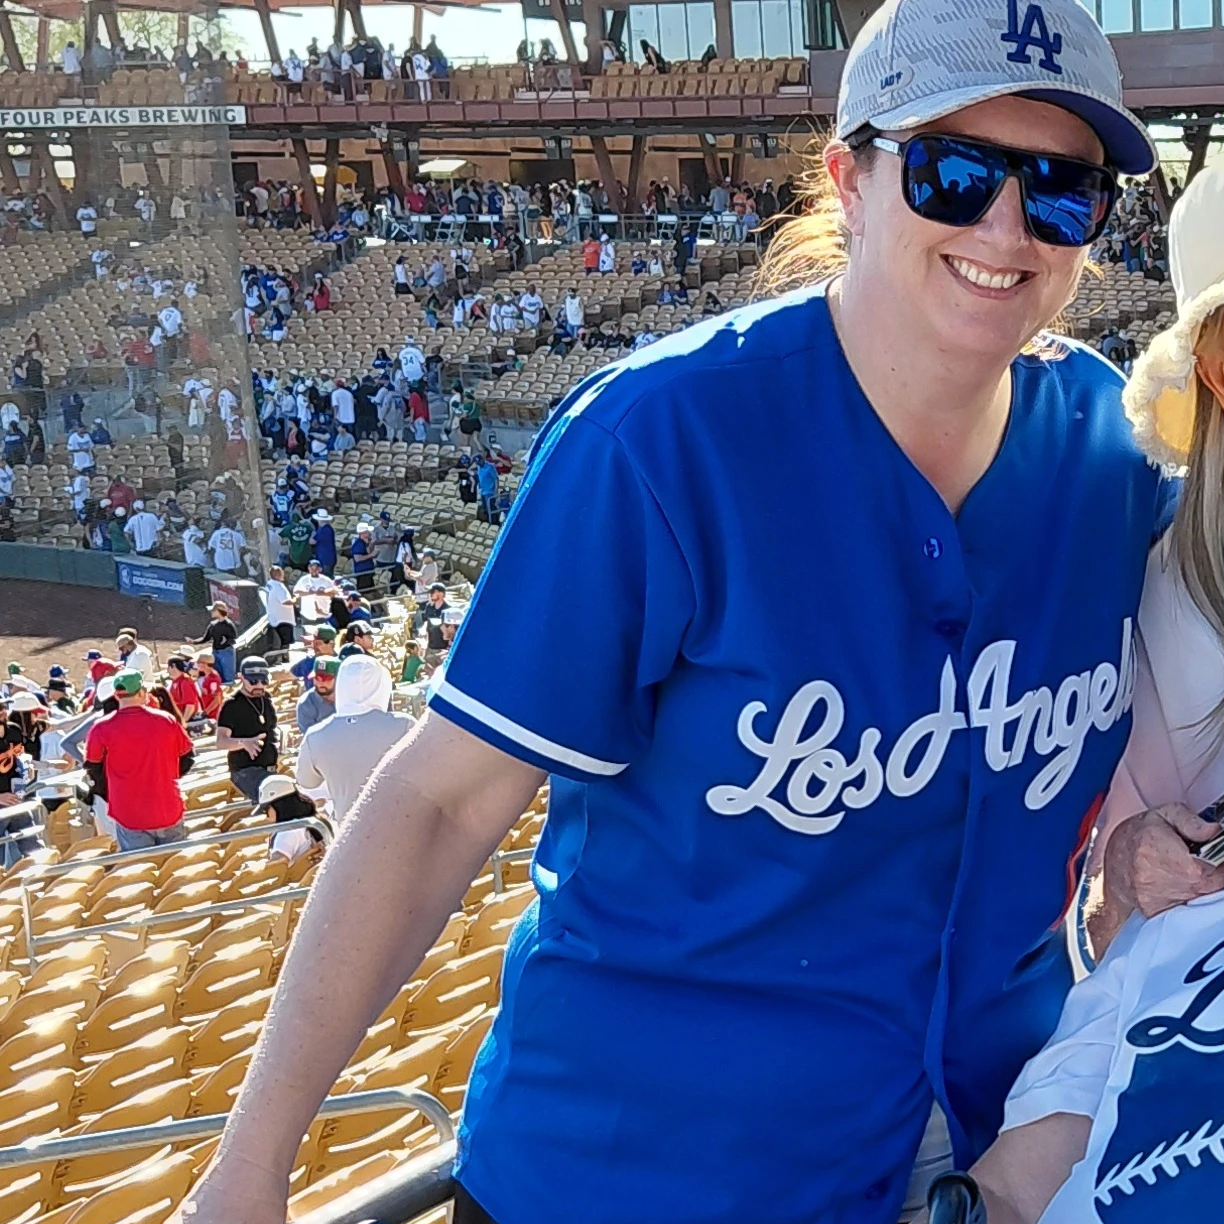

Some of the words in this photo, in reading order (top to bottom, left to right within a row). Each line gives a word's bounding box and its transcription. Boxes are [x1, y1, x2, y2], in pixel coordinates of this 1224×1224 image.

[1000, 0, 1062, 75] LA
[0, 110, 56, 126] FOUR
[63, 108, 131, 125] PEAKS
[138, 107, 237, 123] BREWING
[706, 680, 884, 835] Los
